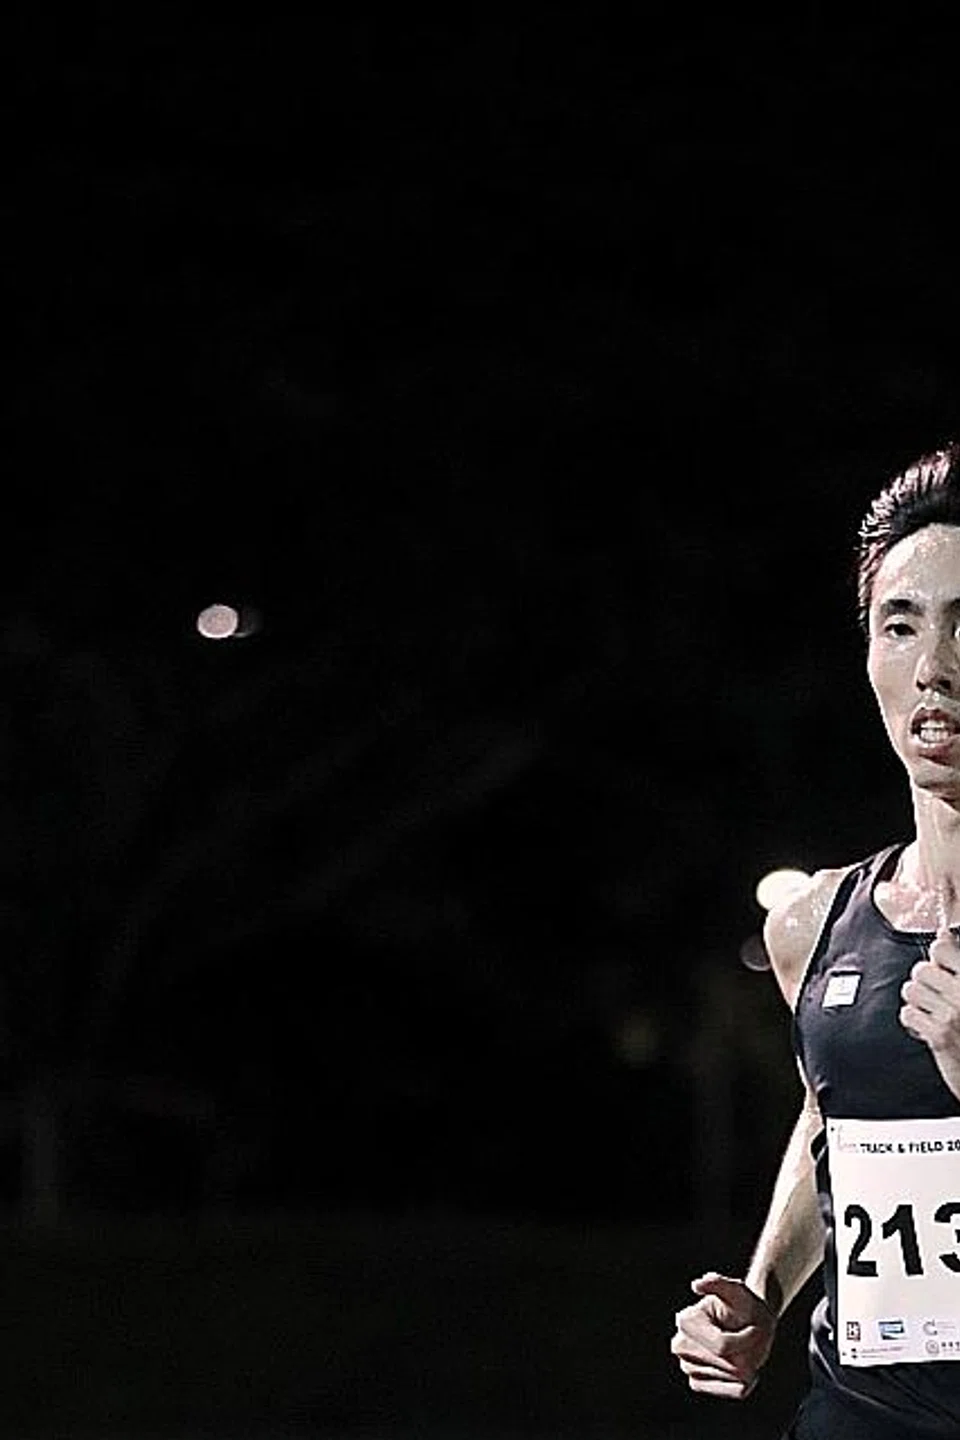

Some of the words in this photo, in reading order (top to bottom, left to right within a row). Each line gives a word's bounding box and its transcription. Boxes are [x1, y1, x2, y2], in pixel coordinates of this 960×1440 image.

[859, 1142, 894, 1154] TRACK
[897, 1142, 905, 1154] &
[909, 1140, 944, 1153] FIELD
